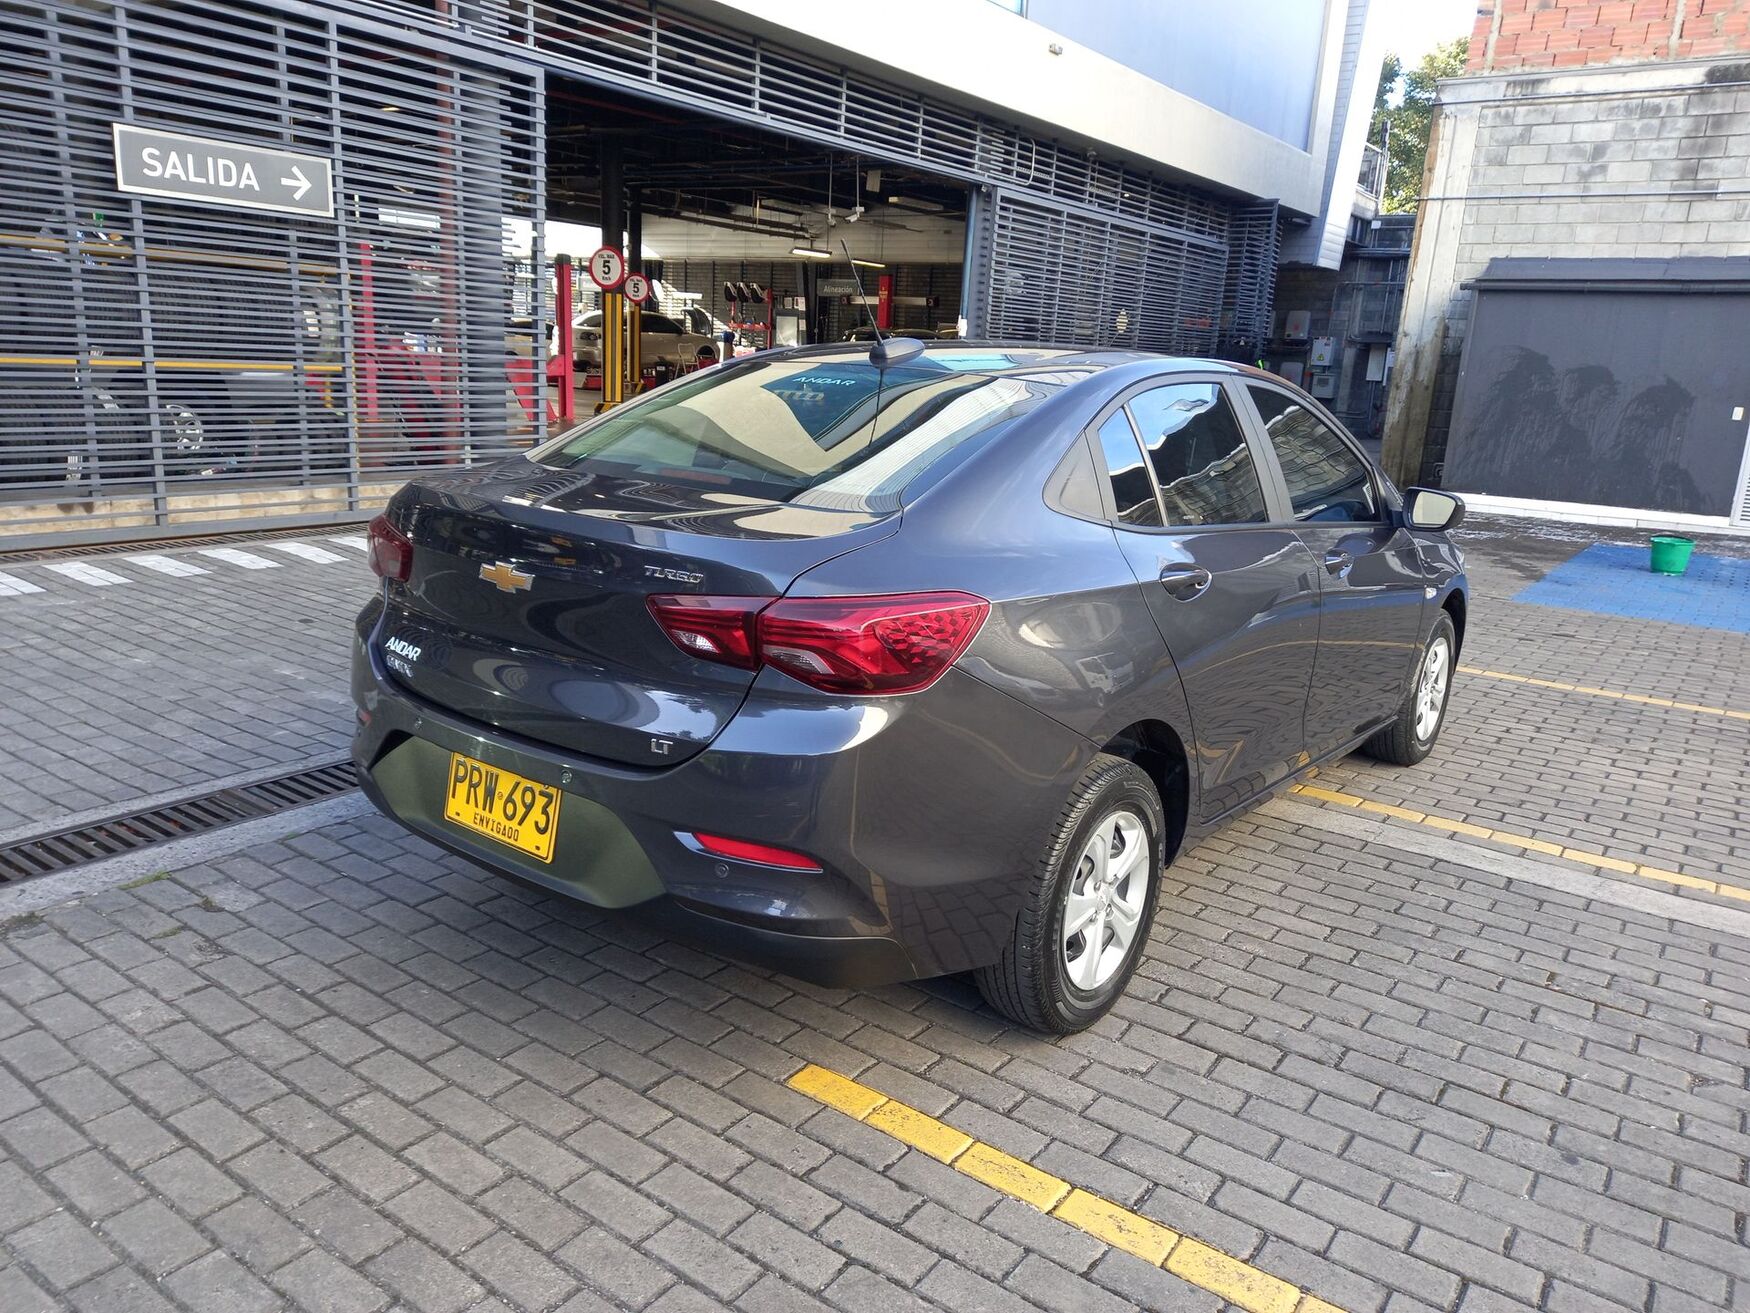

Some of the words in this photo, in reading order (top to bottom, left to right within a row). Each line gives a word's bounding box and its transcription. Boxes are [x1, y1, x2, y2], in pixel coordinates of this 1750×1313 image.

[141, 147, 260, 191] SALIDA
[602, 260, 611, 275] 5
[632, 283, 639, 293] 5
[823, 284, 854, 293] Alineación
[792, 376, 856, 386] ANDAR
[644, 565, 704, 583] TURBO
[385, 636, 421, 661] ANDAR
[651, 738, 674, 755] LT
[473, 812, 521, 842] ENVIGADO
